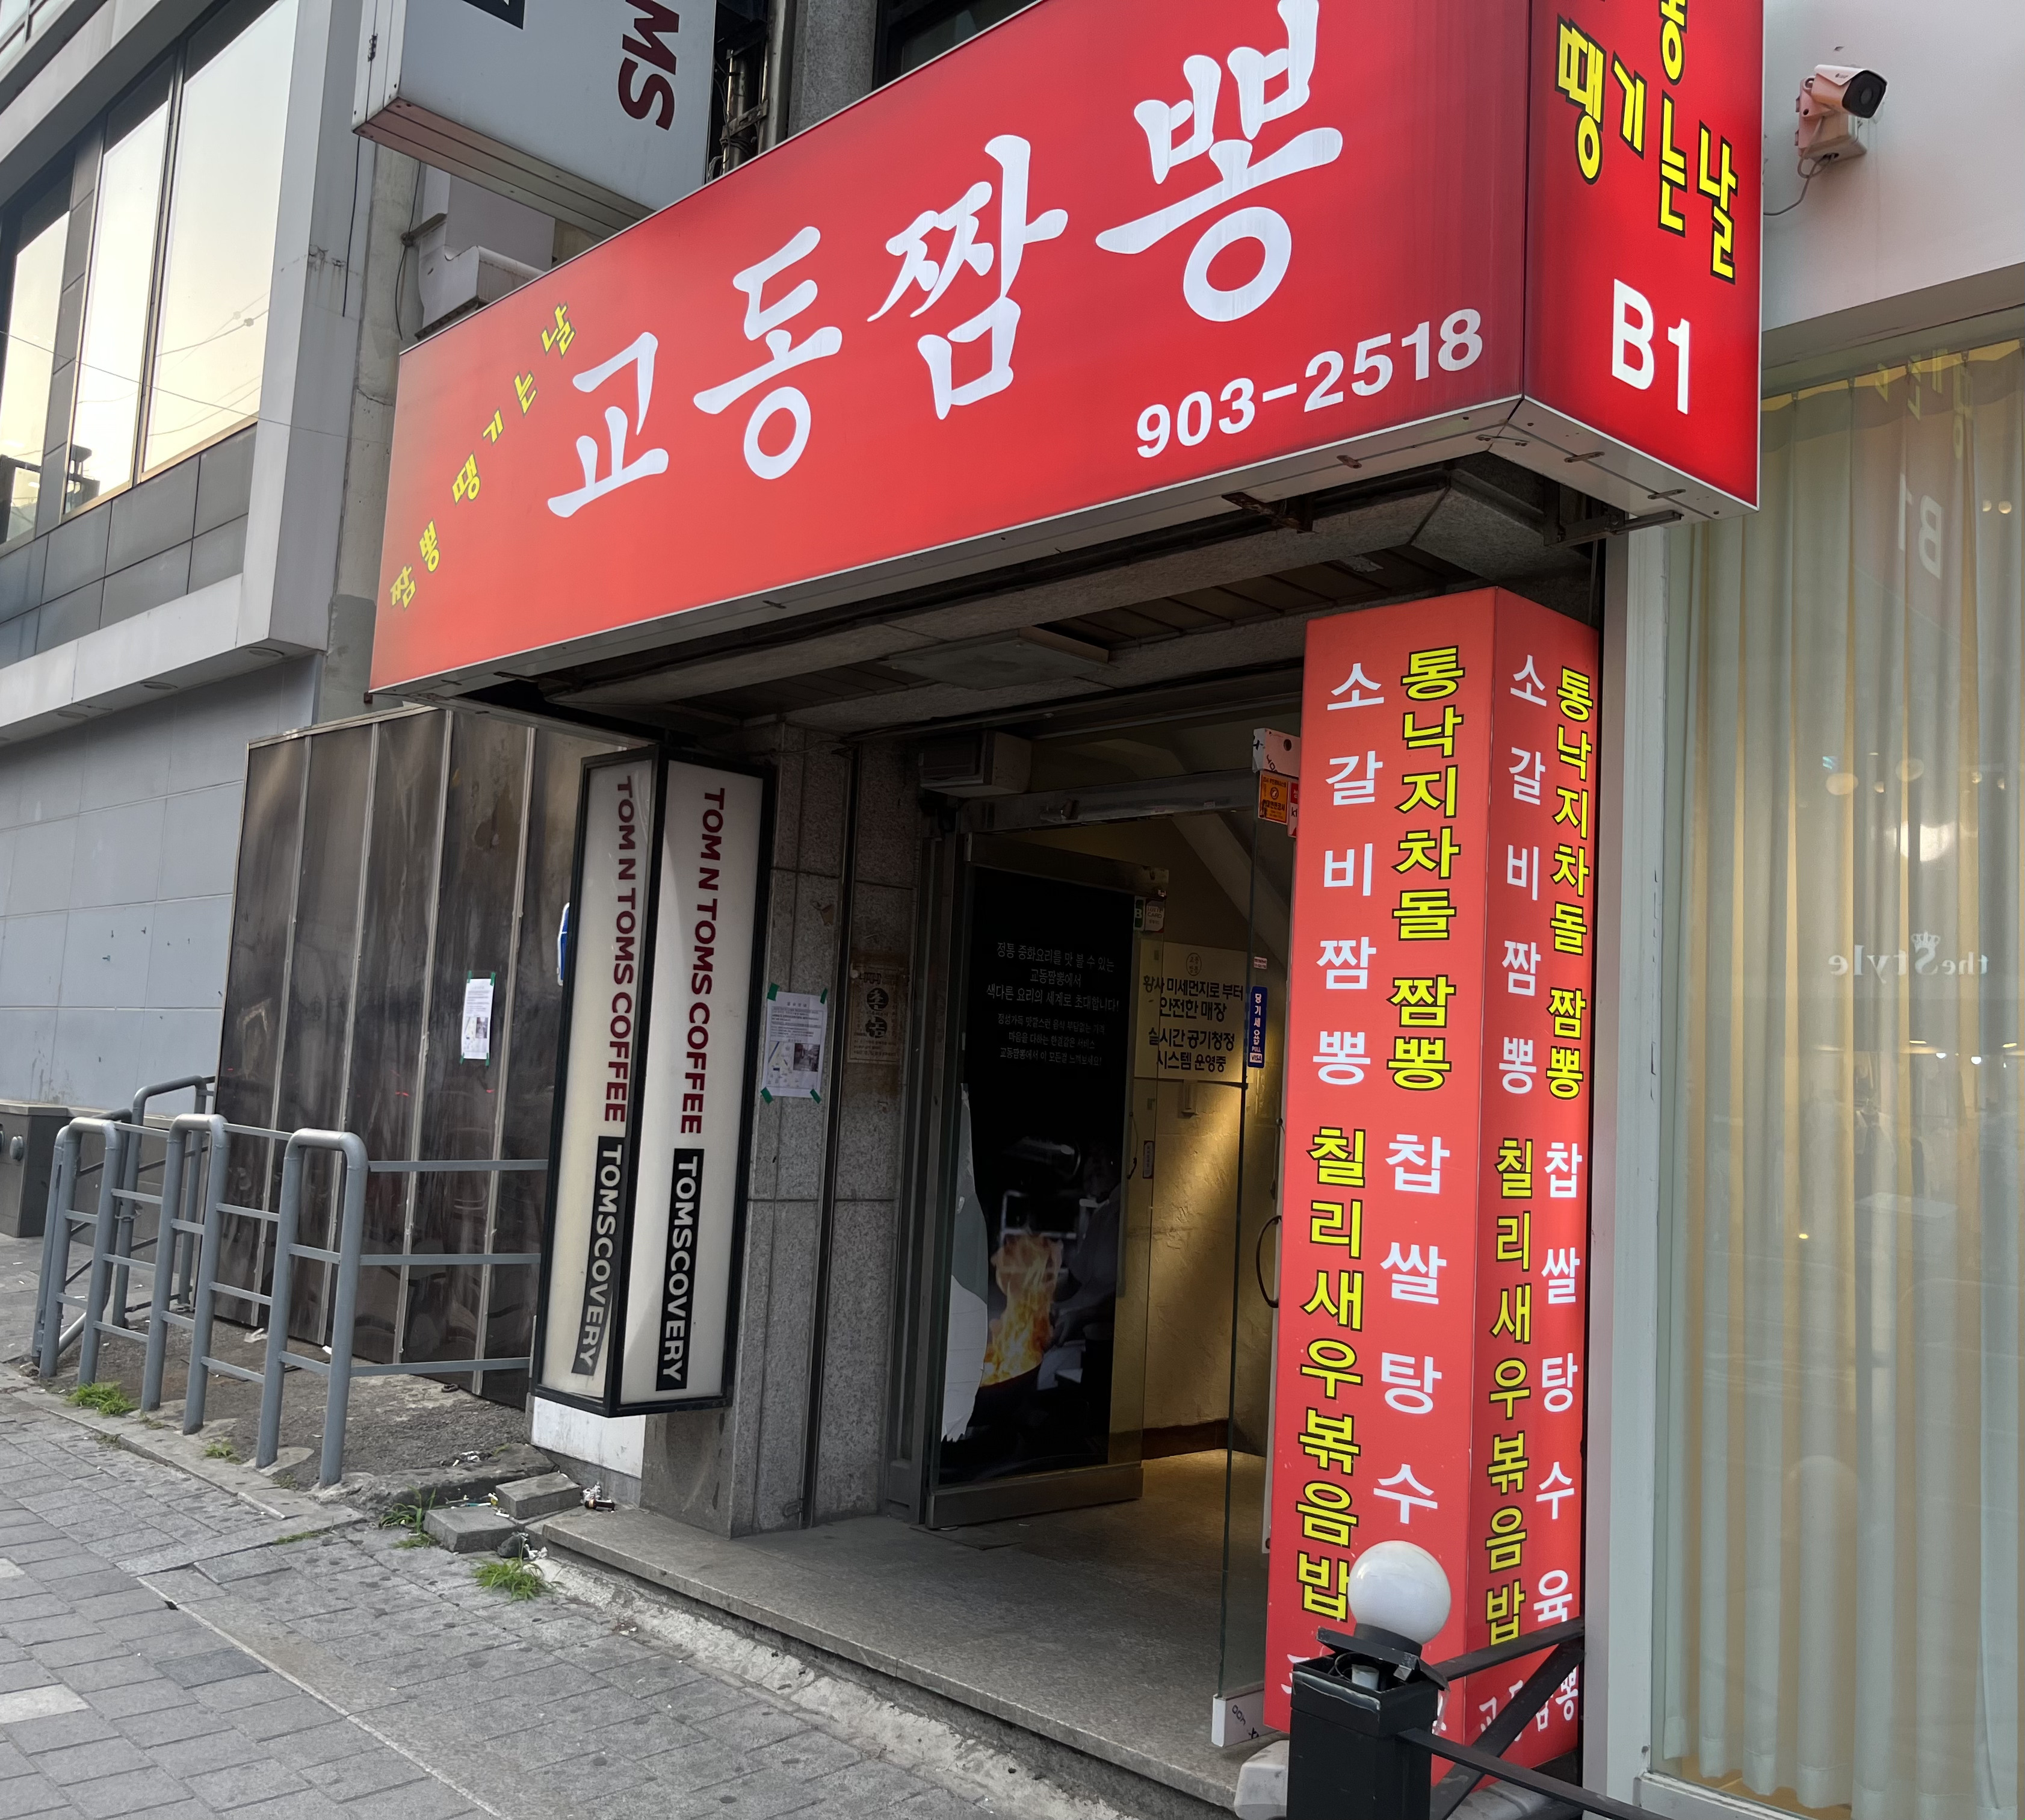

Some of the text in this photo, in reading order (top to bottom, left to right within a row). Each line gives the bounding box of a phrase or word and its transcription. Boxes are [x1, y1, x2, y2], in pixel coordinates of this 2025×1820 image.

[548, 0, 1343, 518] 교동짬뽕
[1611, 278, 1689, 415] B1
[1136, 309, 1483, 459] 903-2518
[605, 775, 636, 1122] TOM N TOMS COFFEE
[681, 788, 725, 1134] TOM N TOMS COFFEE
[997, 942, 1114, 973] 정통 중화요리를 맛 볼 수 있는
[1030, 968, 1081, 988] 교동짬뽕에서
[1143, 975, 1243, 1001] 황사 미세먼지로 부터
[987, 983, 1119, 1012] 색다른 요리의 세계로 초대합니다!
[1160, 997, 1227, 1023] 안전한 매장
[1053, 1020, 1065, 1030] 음식
[1009, 1032, 1027, 1044] 마음을
[1078, 1038, 1095, 1050] 서비스
[1188, 1030, 1234, 1051] 공기청정
[1157, 1051, 1226, 1072] 시스템 운영중
[580, 1144, 621, 1367] TOMSCOVERY
[663, 1156, 698, 1381] TOMSCOVERY
